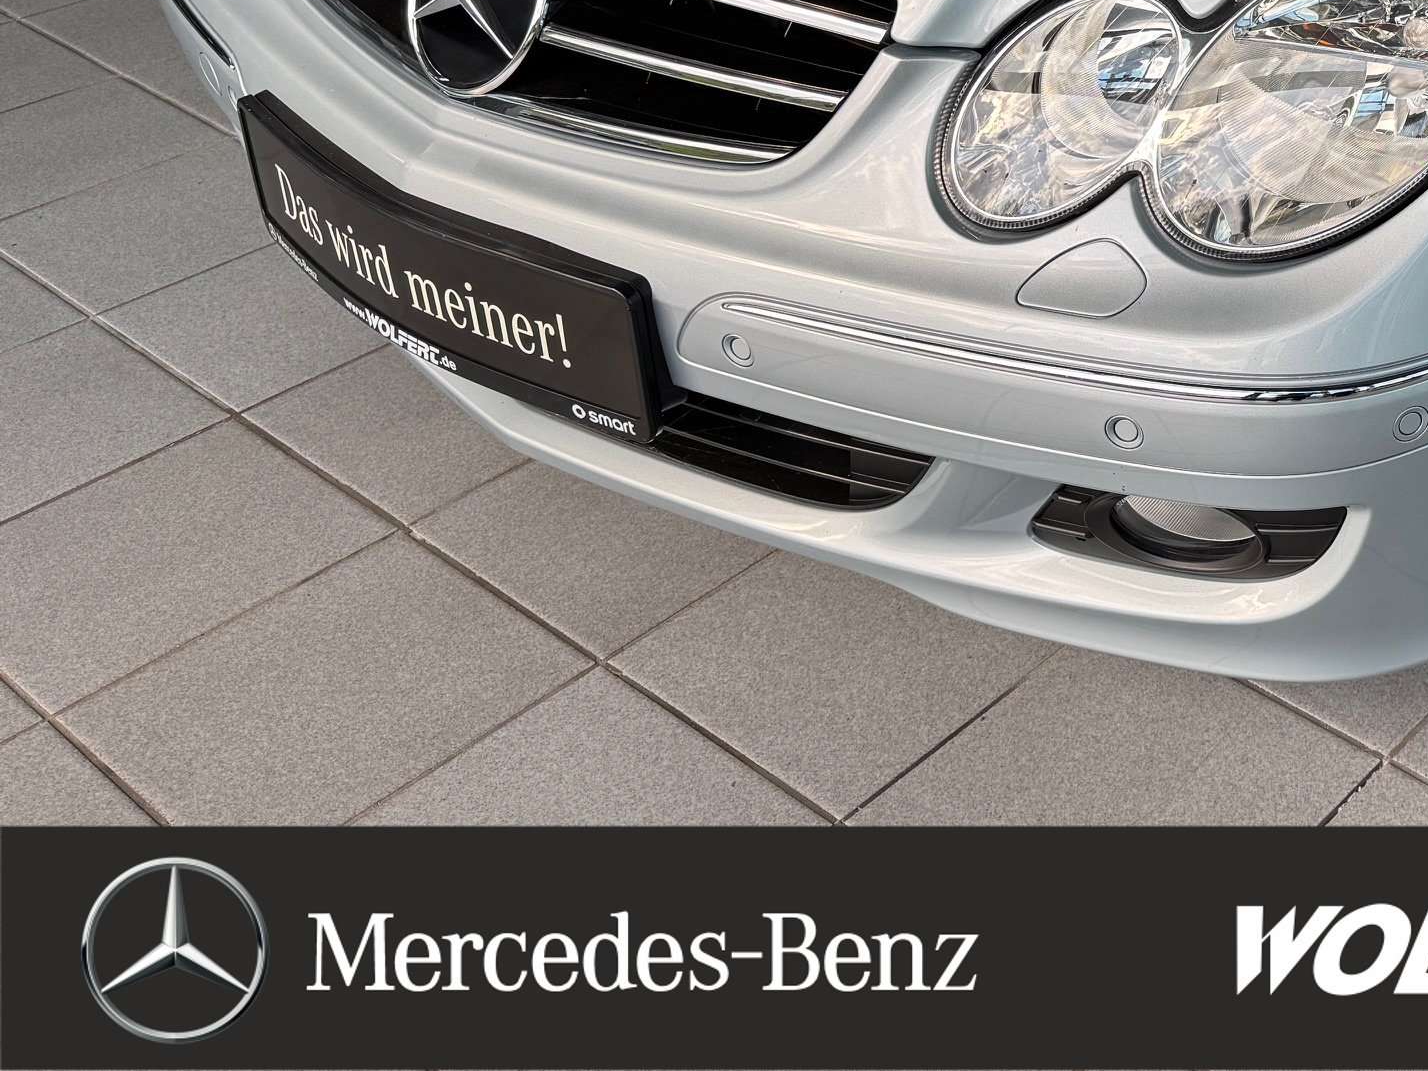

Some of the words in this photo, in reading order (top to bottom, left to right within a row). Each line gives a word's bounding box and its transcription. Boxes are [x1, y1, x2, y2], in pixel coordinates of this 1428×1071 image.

[275, 163, 324, 246] Das
[325, 219, 399, 299] wird
[403, 270, 572, 369] meiner!
[343, 297, 457, 371] www.WOLFERT.de
[588, 410, 637, 436] smart
